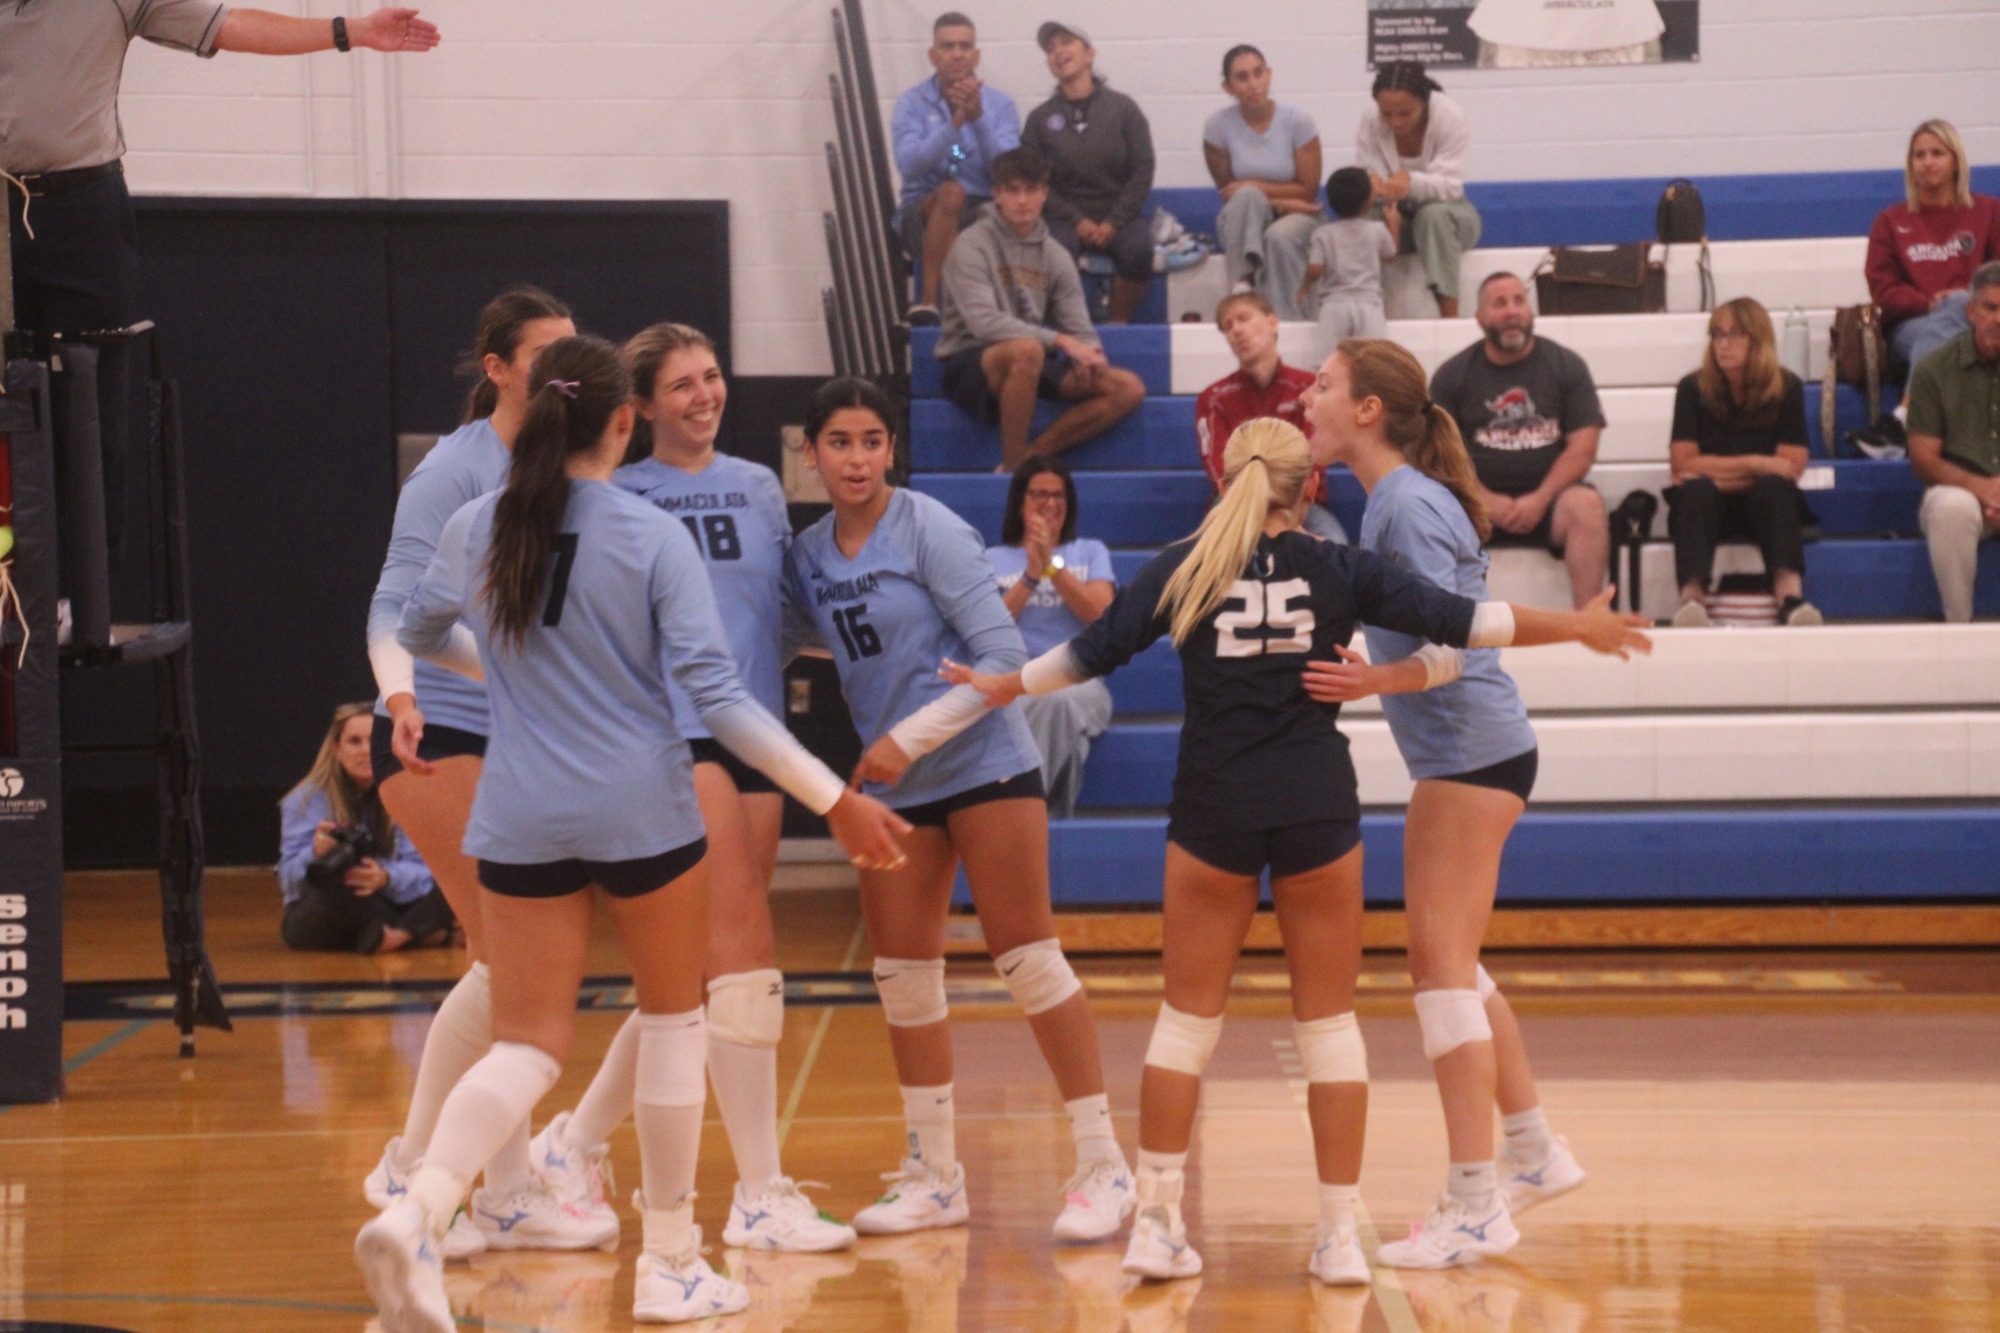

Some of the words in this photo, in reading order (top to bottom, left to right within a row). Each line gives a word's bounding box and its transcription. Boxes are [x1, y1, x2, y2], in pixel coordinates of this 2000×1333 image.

[681, 514, 742, 561] 18
[833, 602, 882, 662] 16
[1213, 577, 1316, 657] 25
